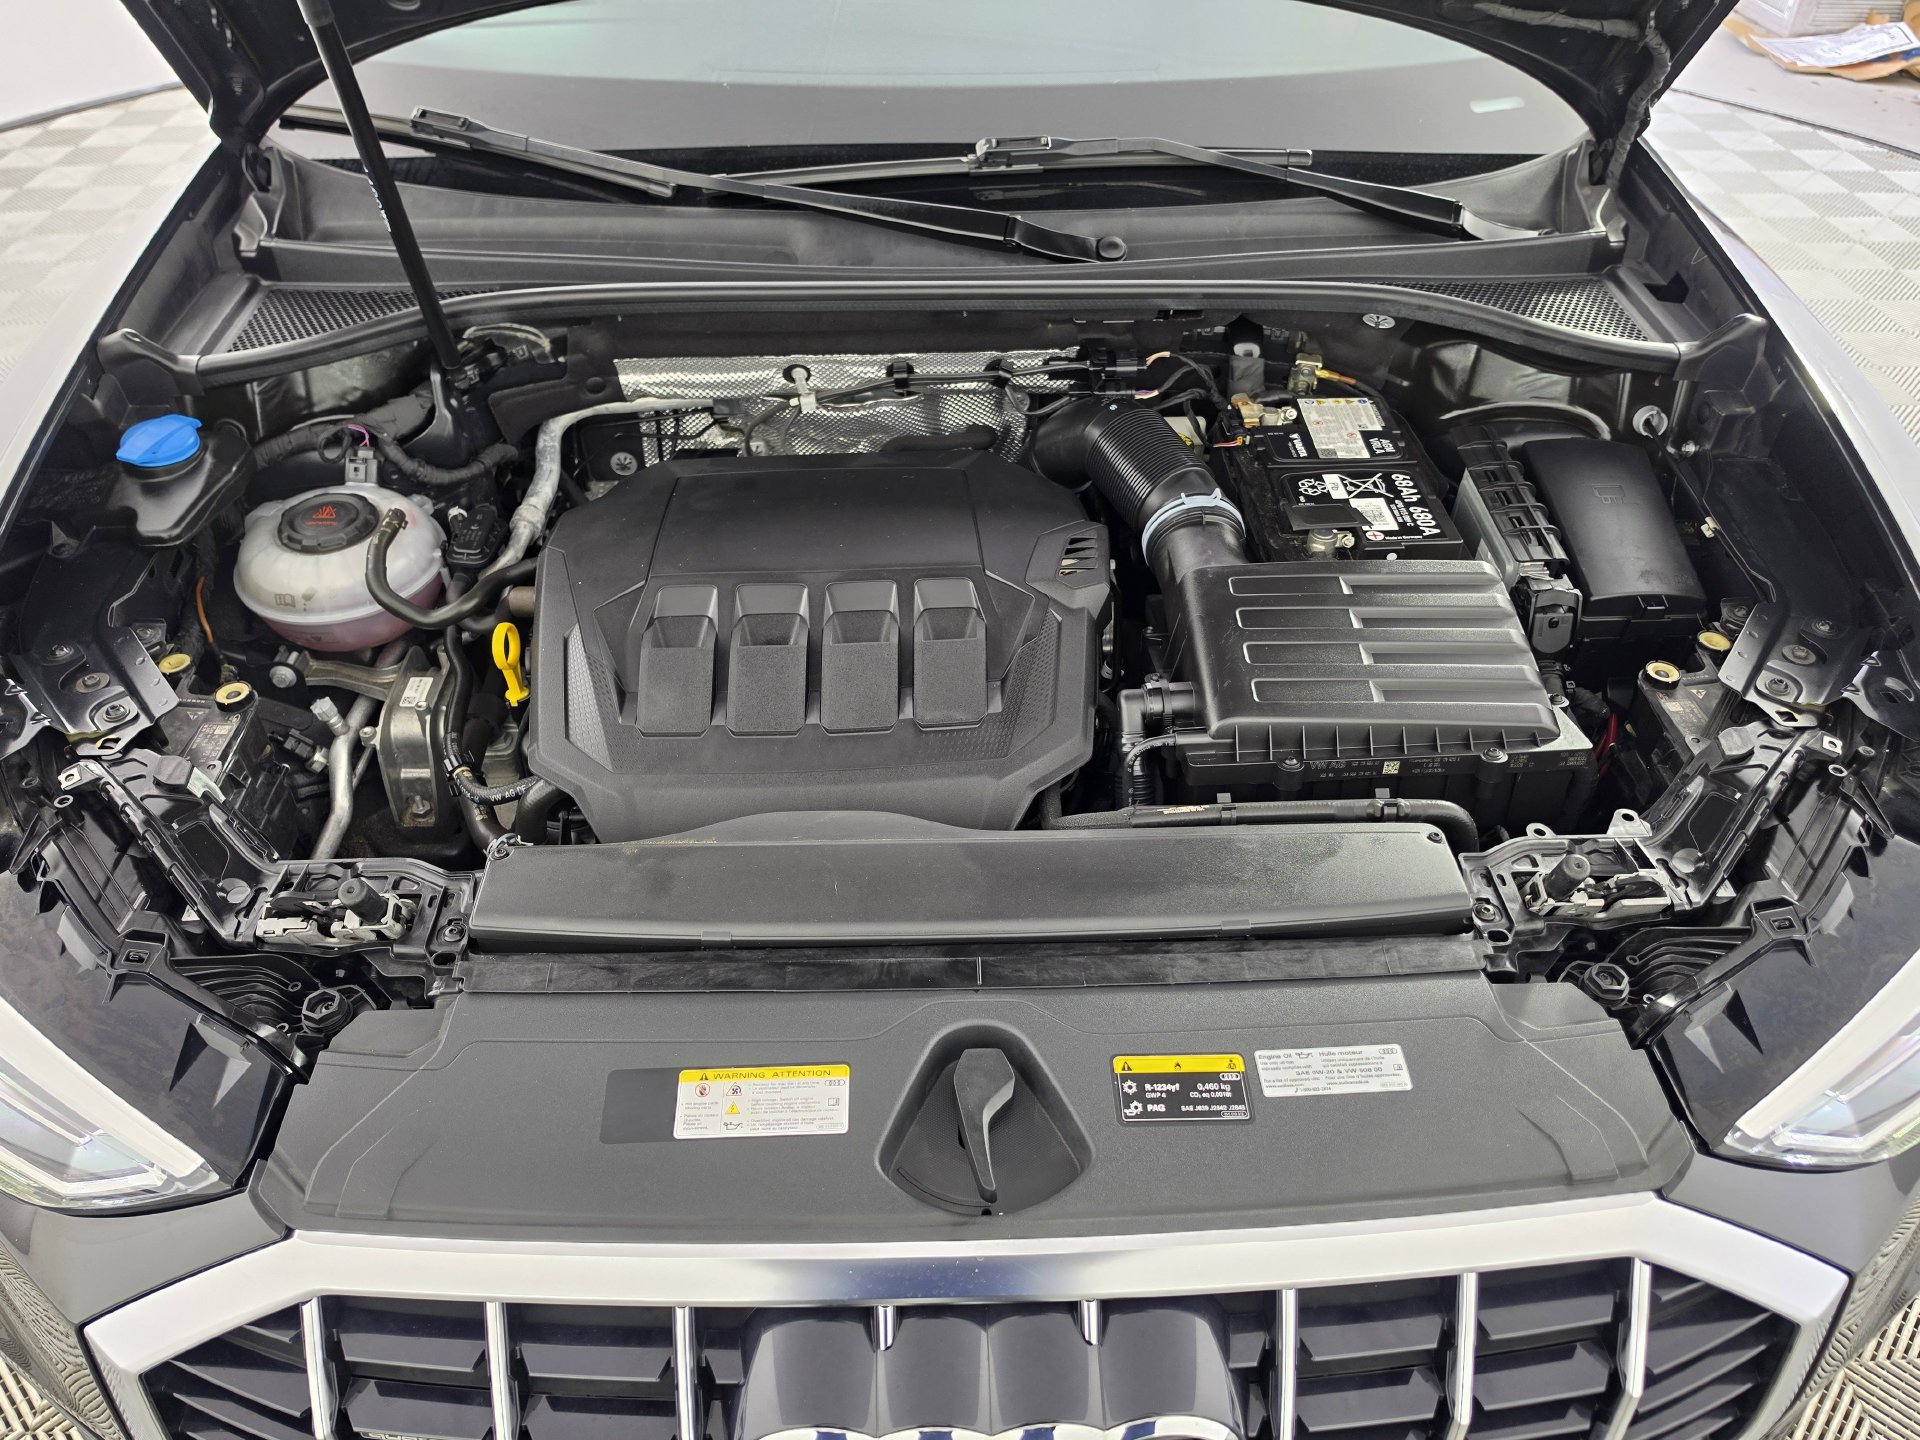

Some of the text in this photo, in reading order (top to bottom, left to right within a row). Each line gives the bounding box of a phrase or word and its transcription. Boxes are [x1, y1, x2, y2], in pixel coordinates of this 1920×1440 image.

[1368, 437, 1385, 454] VRLA
[1379, 438, 1396, 453] AGM
[1391, 473, 1422, 502] 68Ah
[1409, 506, 1441, 537] 680A
[489, 793, 502, 802] VW
[505, 788, 516, 799] AG
[713, 1069, 831, 1080] WARNING ATTENTION
[1144, 1083, 1180, 1093] R-1234yf
[1220, 1082, 1231, 1092] kg
[1146, 1103, 1166, 1112] PAG
